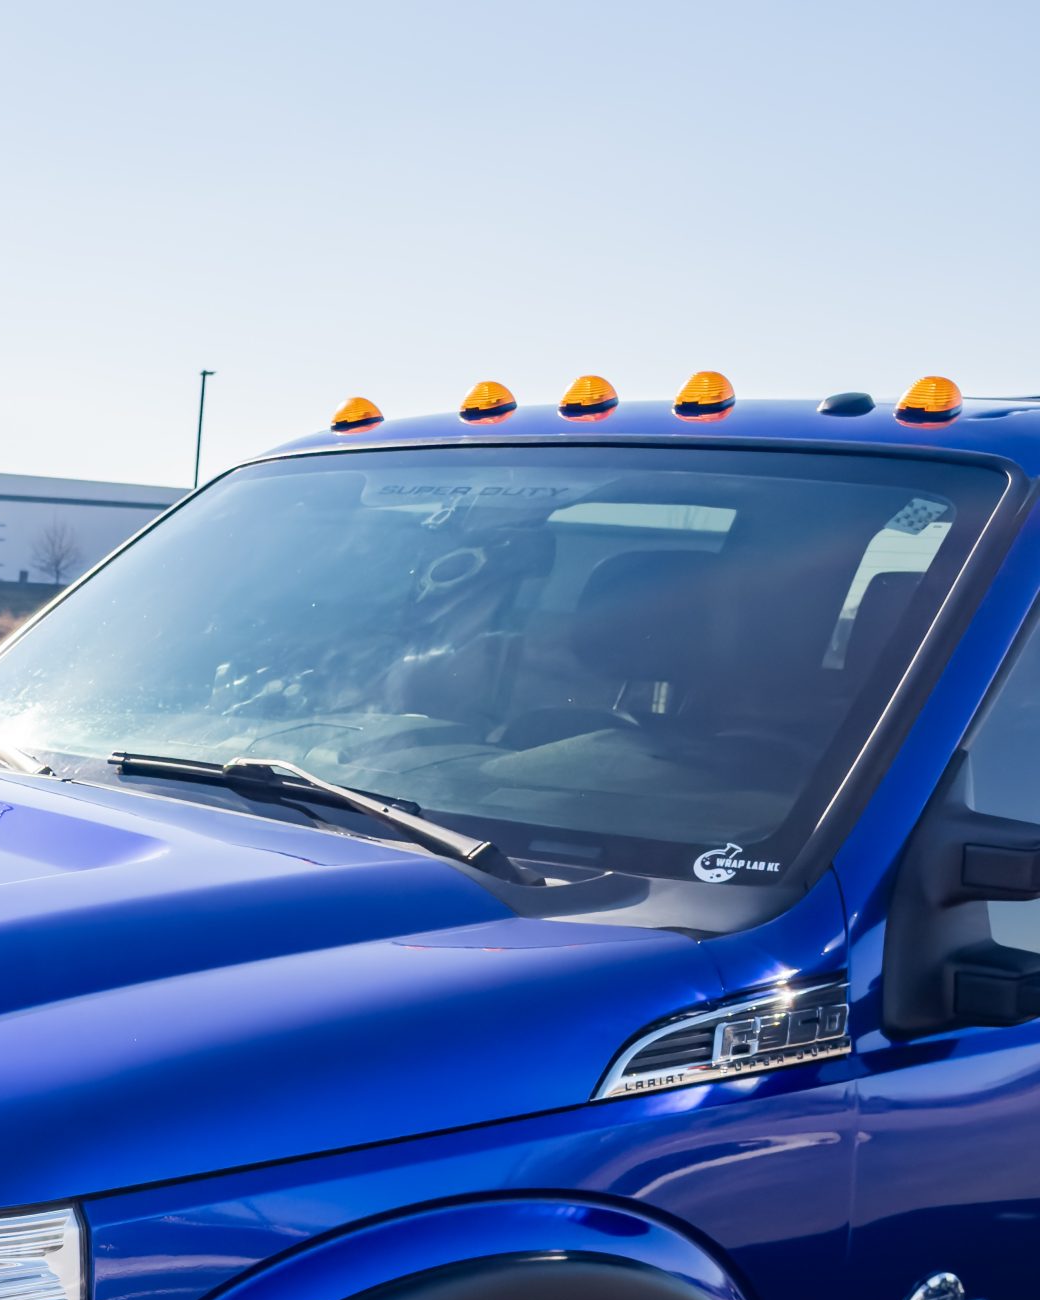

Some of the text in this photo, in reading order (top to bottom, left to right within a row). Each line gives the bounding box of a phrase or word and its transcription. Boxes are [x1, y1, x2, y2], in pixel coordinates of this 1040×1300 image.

[378, 485, 569, 497] SUPER DUTY
[716, 858, 745, 869] WRAP
[766, 862, 780, 872] KC
[625, 1073, 684, 1091] LARIAT
